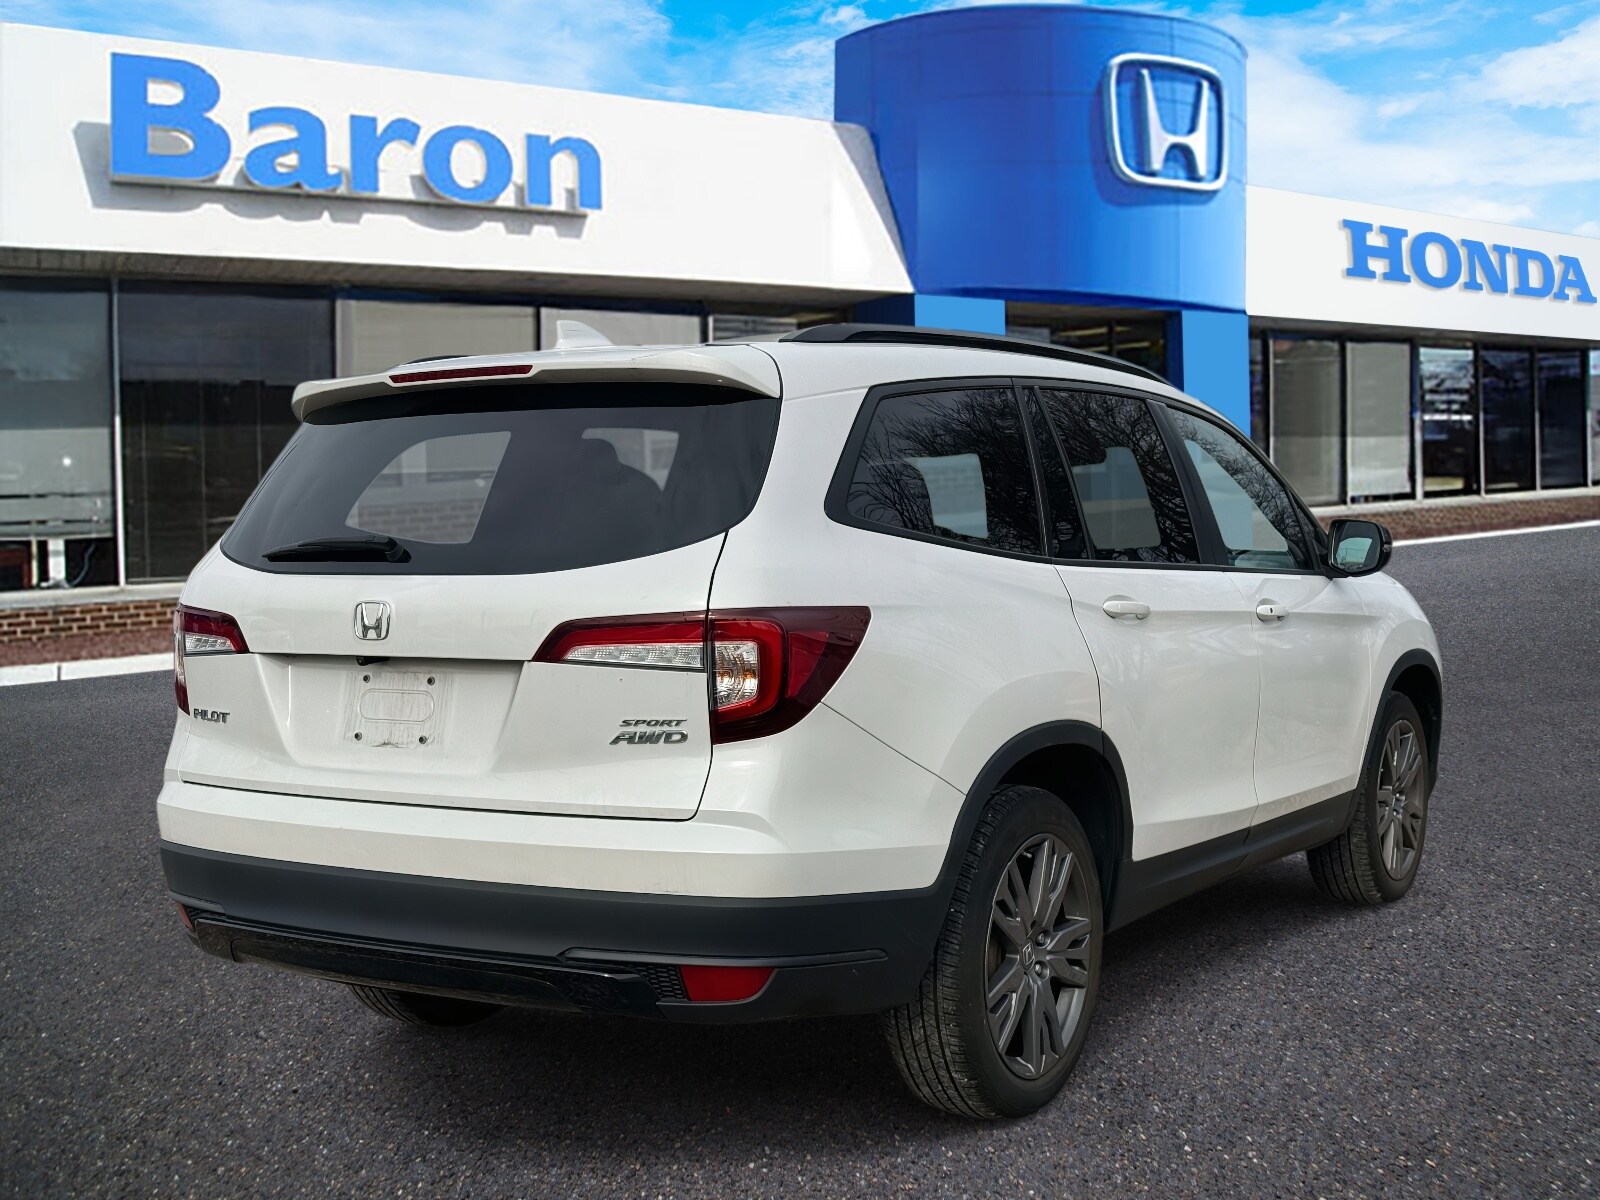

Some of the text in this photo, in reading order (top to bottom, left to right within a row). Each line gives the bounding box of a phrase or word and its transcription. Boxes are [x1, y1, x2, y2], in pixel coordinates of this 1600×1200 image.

[110, 52, 602, 210] Baron
[1342, 218, 1597, 304] HONDA
[193, 707, 231, 724] PILOT
[619, 718, 688, 728] SPORT
[608, 729, 689, 746] AWD
